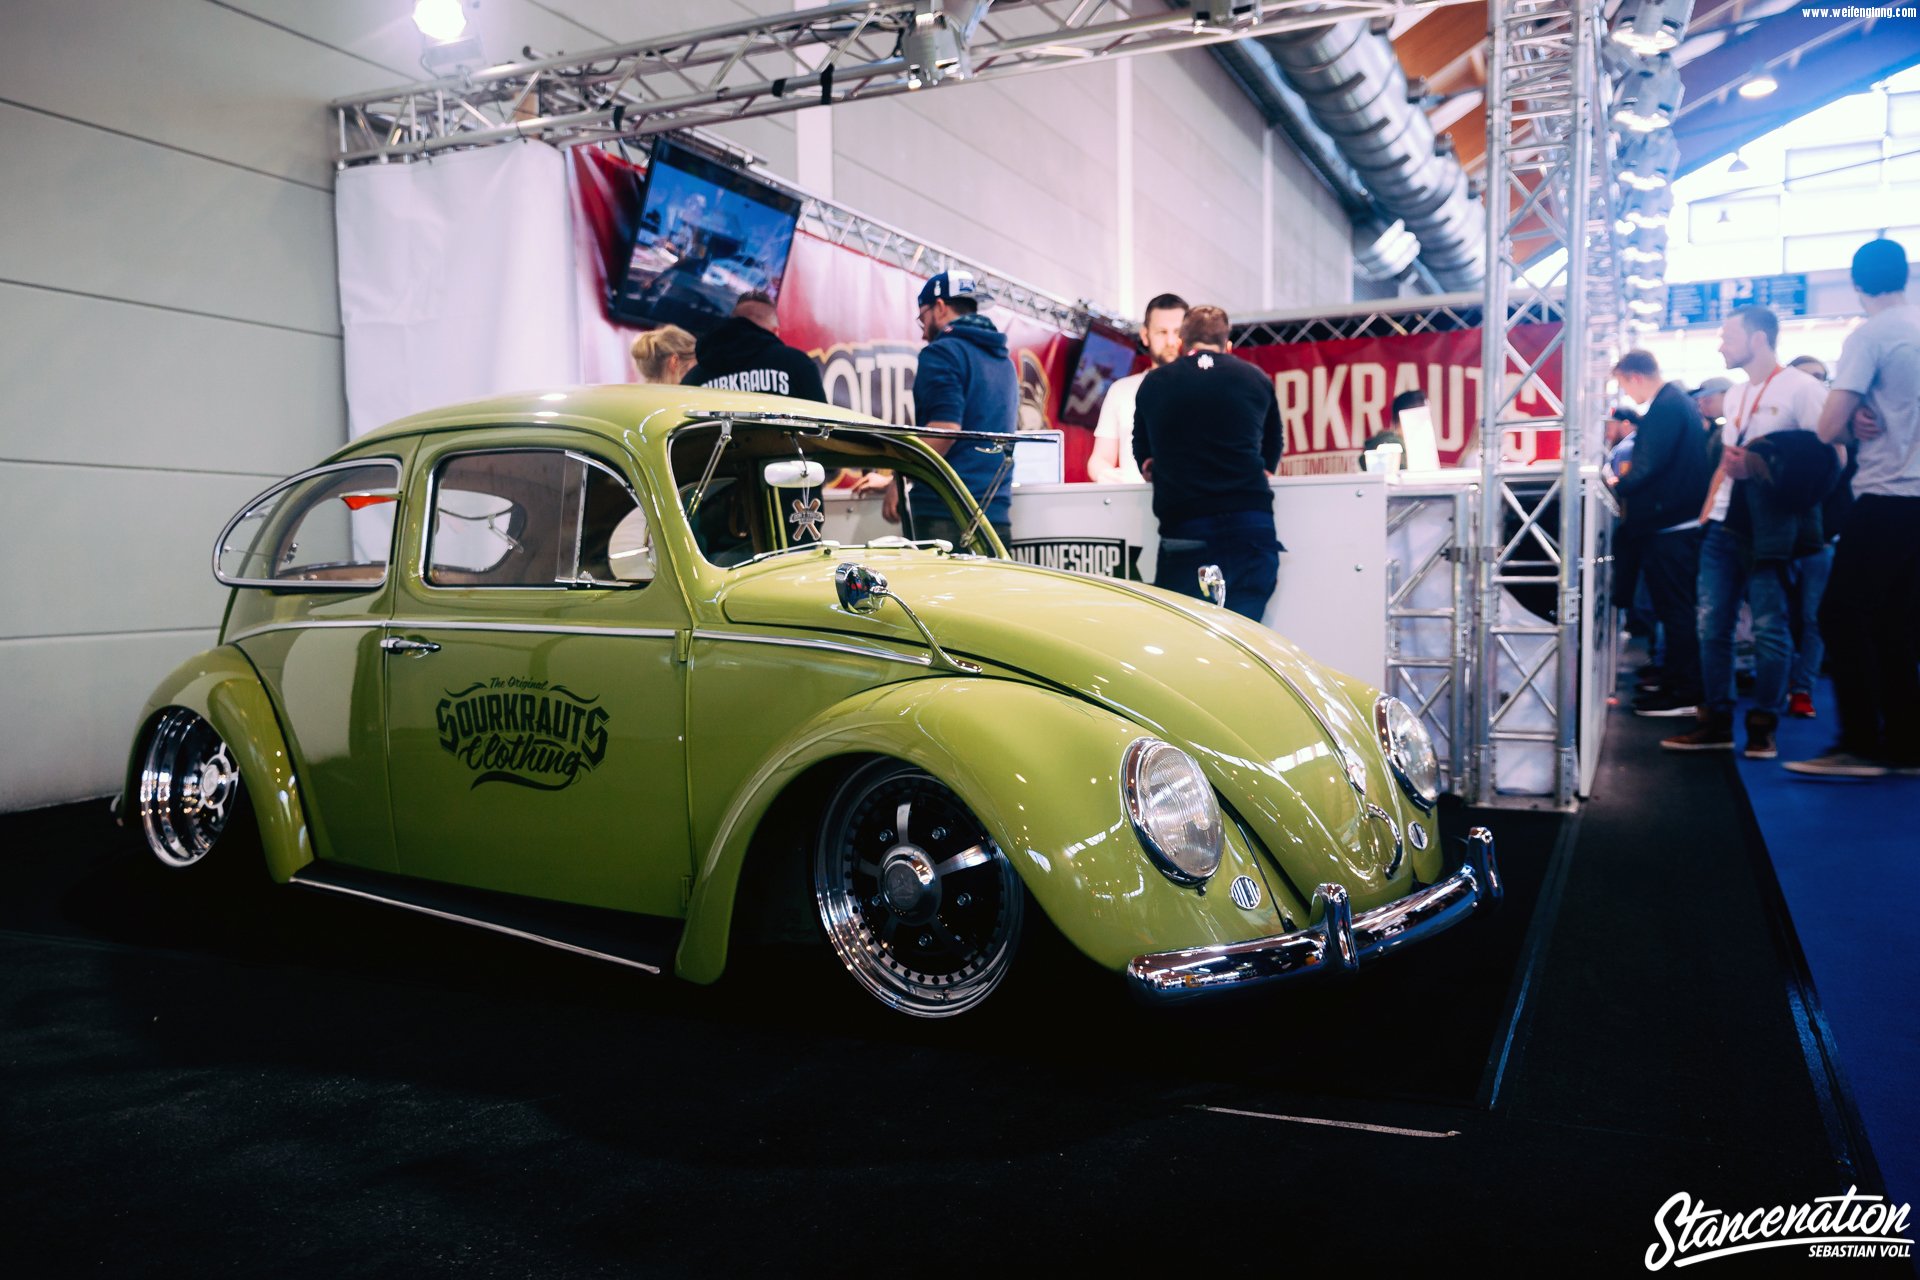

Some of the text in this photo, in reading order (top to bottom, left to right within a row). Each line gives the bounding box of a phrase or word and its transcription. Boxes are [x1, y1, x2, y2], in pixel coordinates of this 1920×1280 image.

[701, 368, 790, 396] RKRAUTS
[490, 676, 549, 691] The Original
[436, 693, 611, 770] SOURKRAUTS
[458, 733, 591, 780] Clothing
